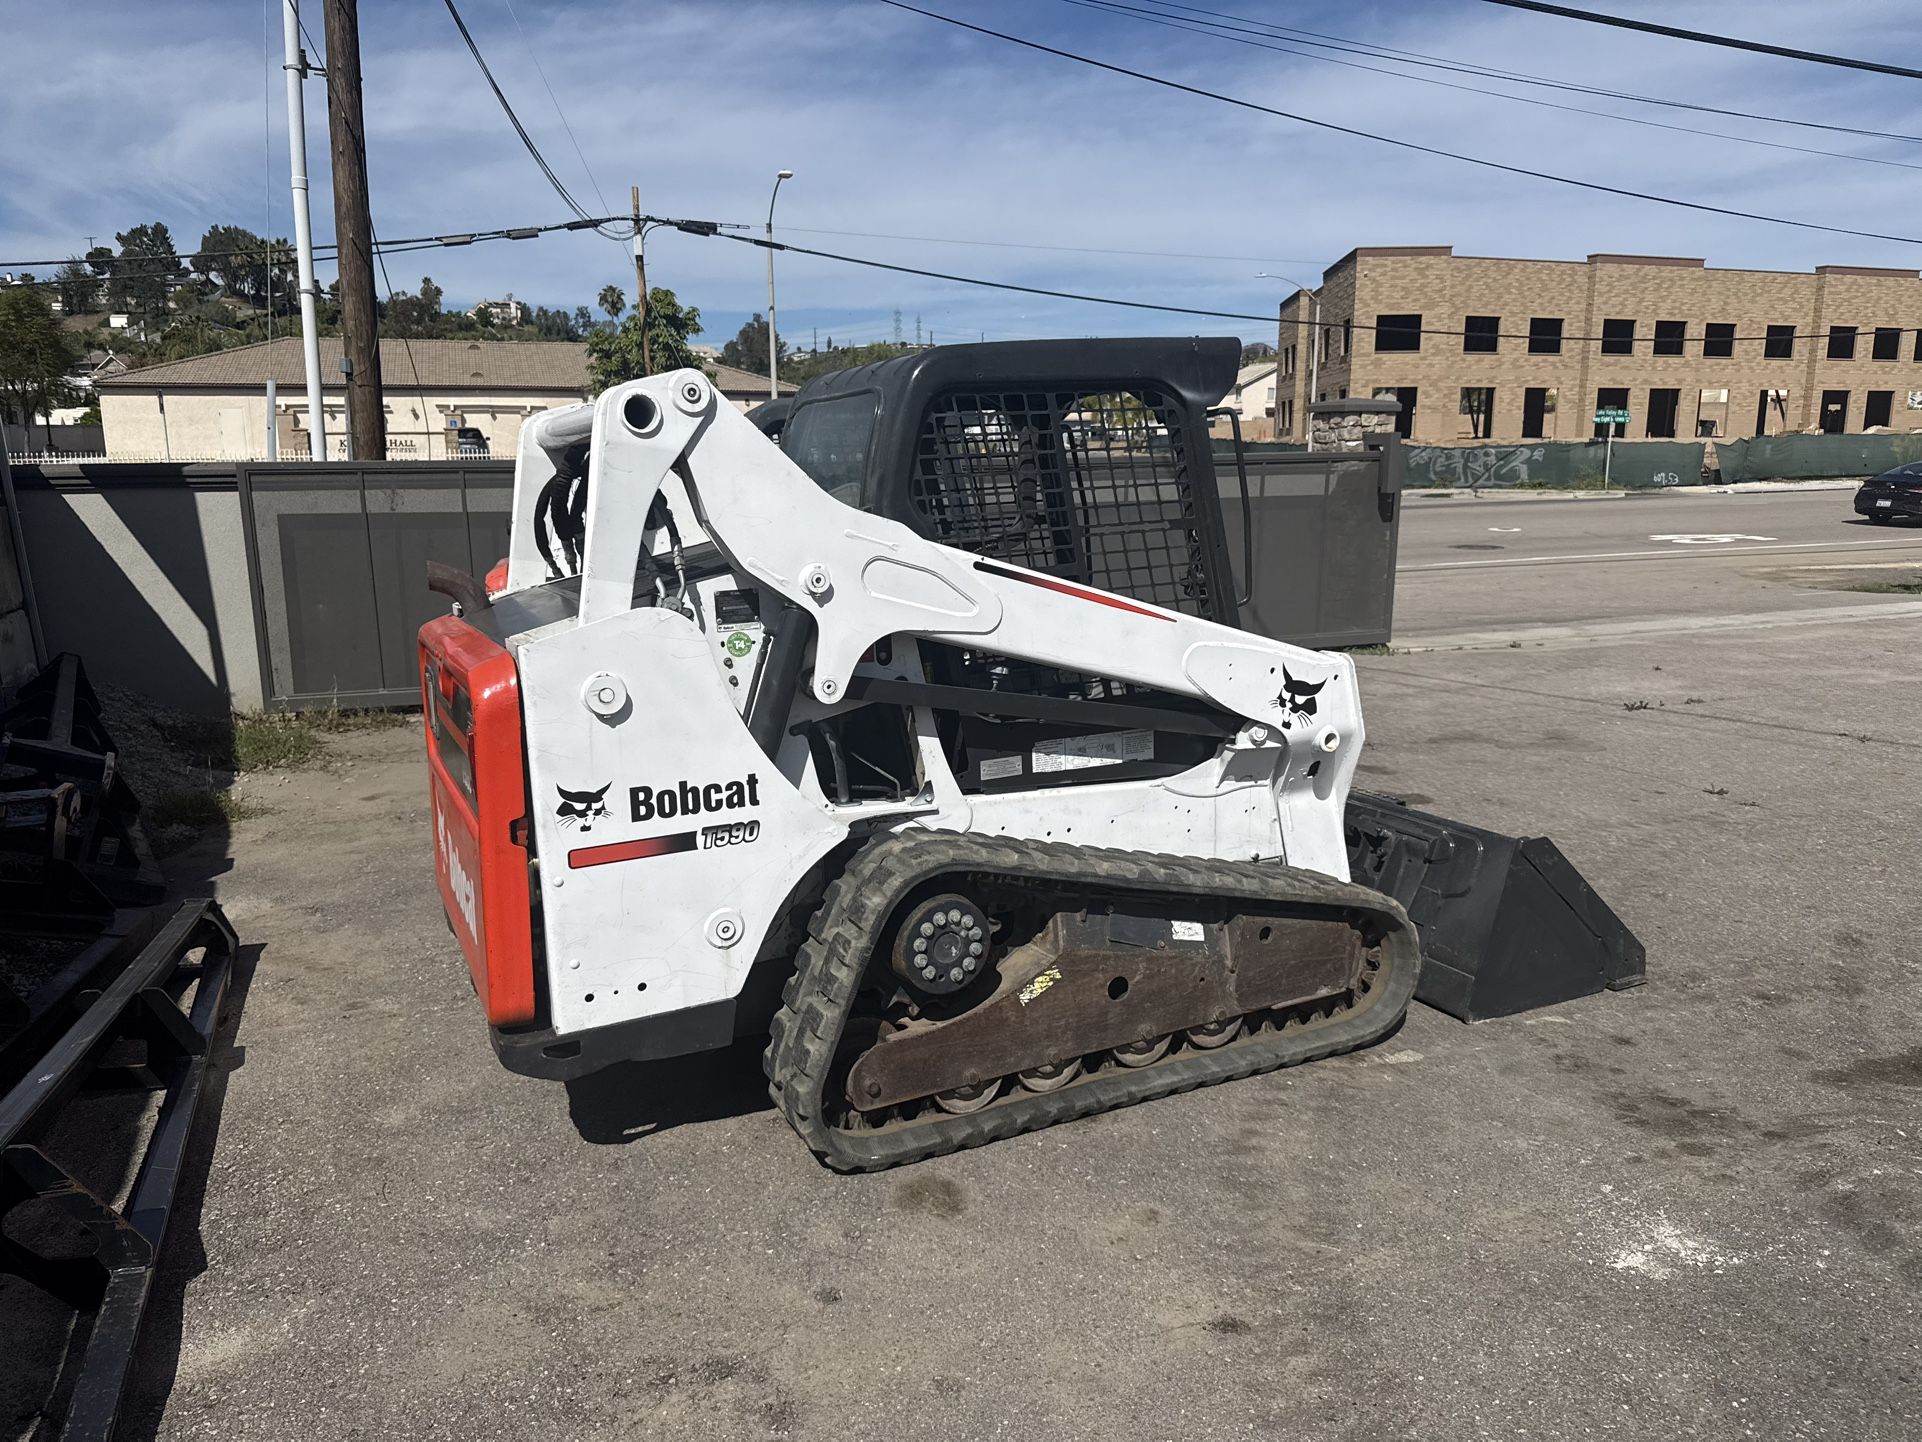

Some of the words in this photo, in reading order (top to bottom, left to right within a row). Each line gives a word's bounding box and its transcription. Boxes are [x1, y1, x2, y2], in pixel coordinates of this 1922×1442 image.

[389, 439, 416, 447] HALL
[733, 640, 745, 649] T4
[629, 773, 760, 823] Bobcat
[701, 820, 760, 849] T590
